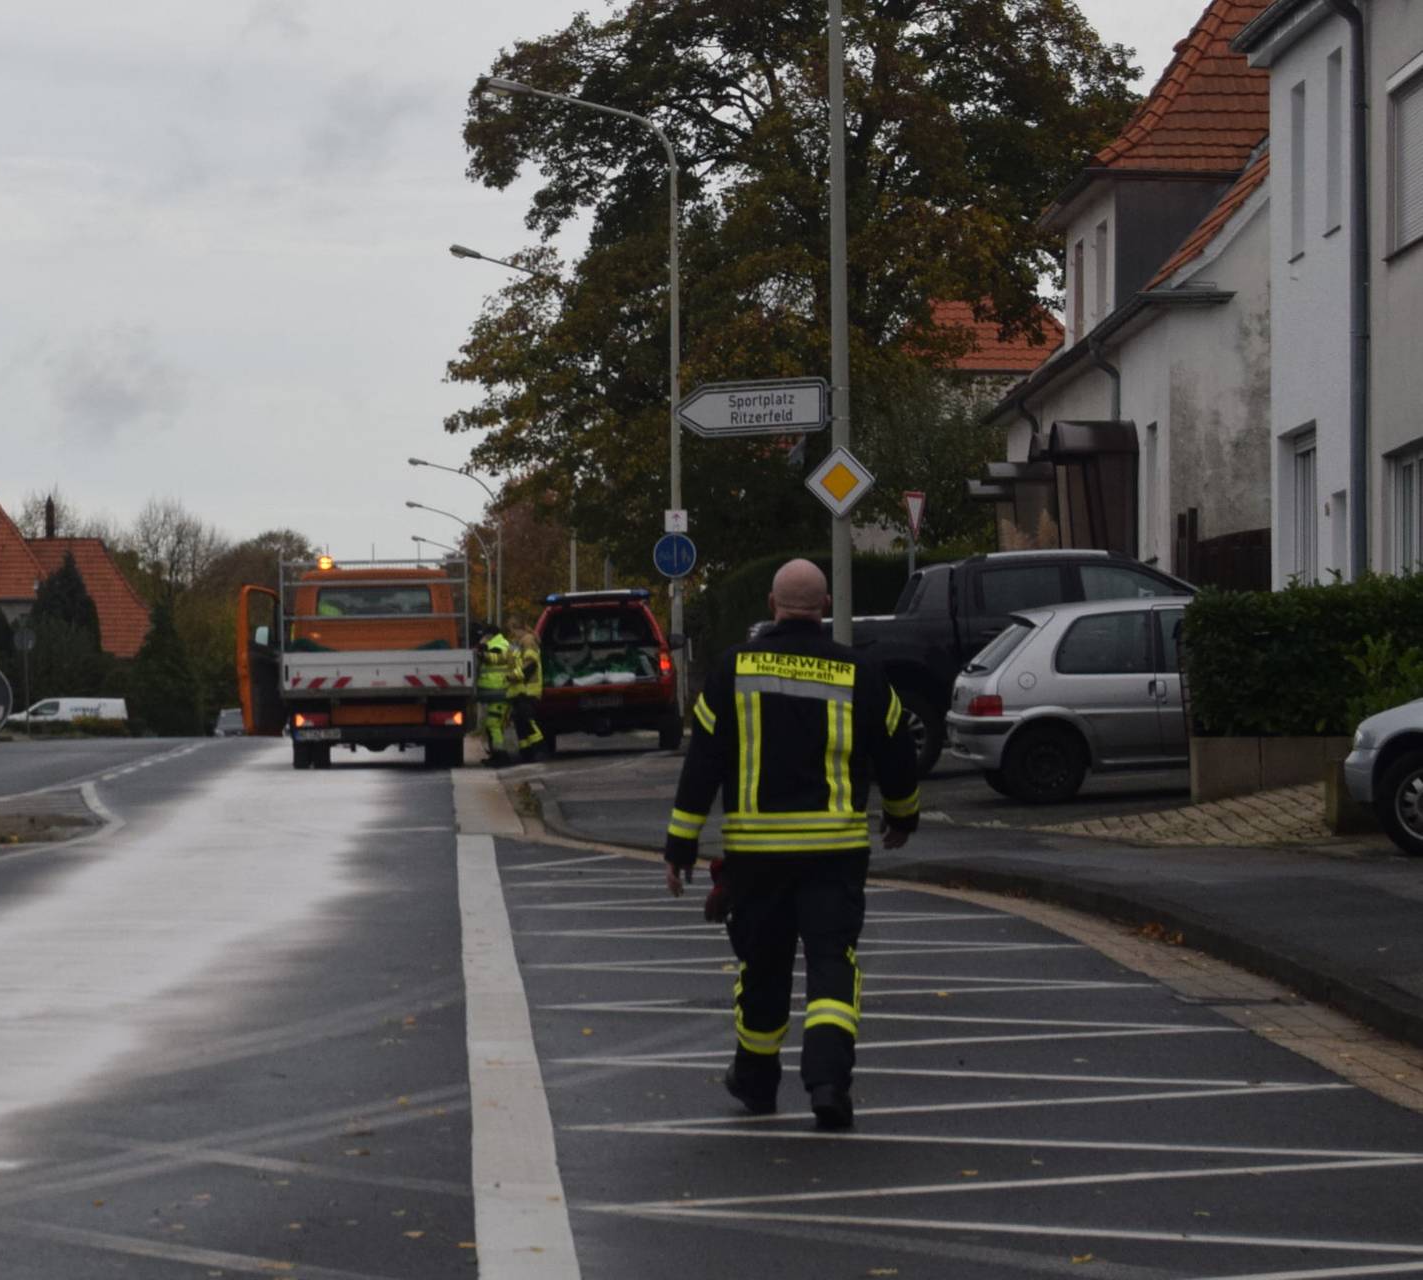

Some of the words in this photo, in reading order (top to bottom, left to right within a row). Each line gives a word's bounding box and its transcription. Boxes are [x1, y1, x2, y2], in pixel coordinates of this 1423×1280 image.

[728, 393, 795, 409] Sportplatz
[730, 408, 793, 425] Ritzerfeld
[739, 652, 852, 675] FEUERWEHR
[756, 663, 835, 681] Herzogenrath
